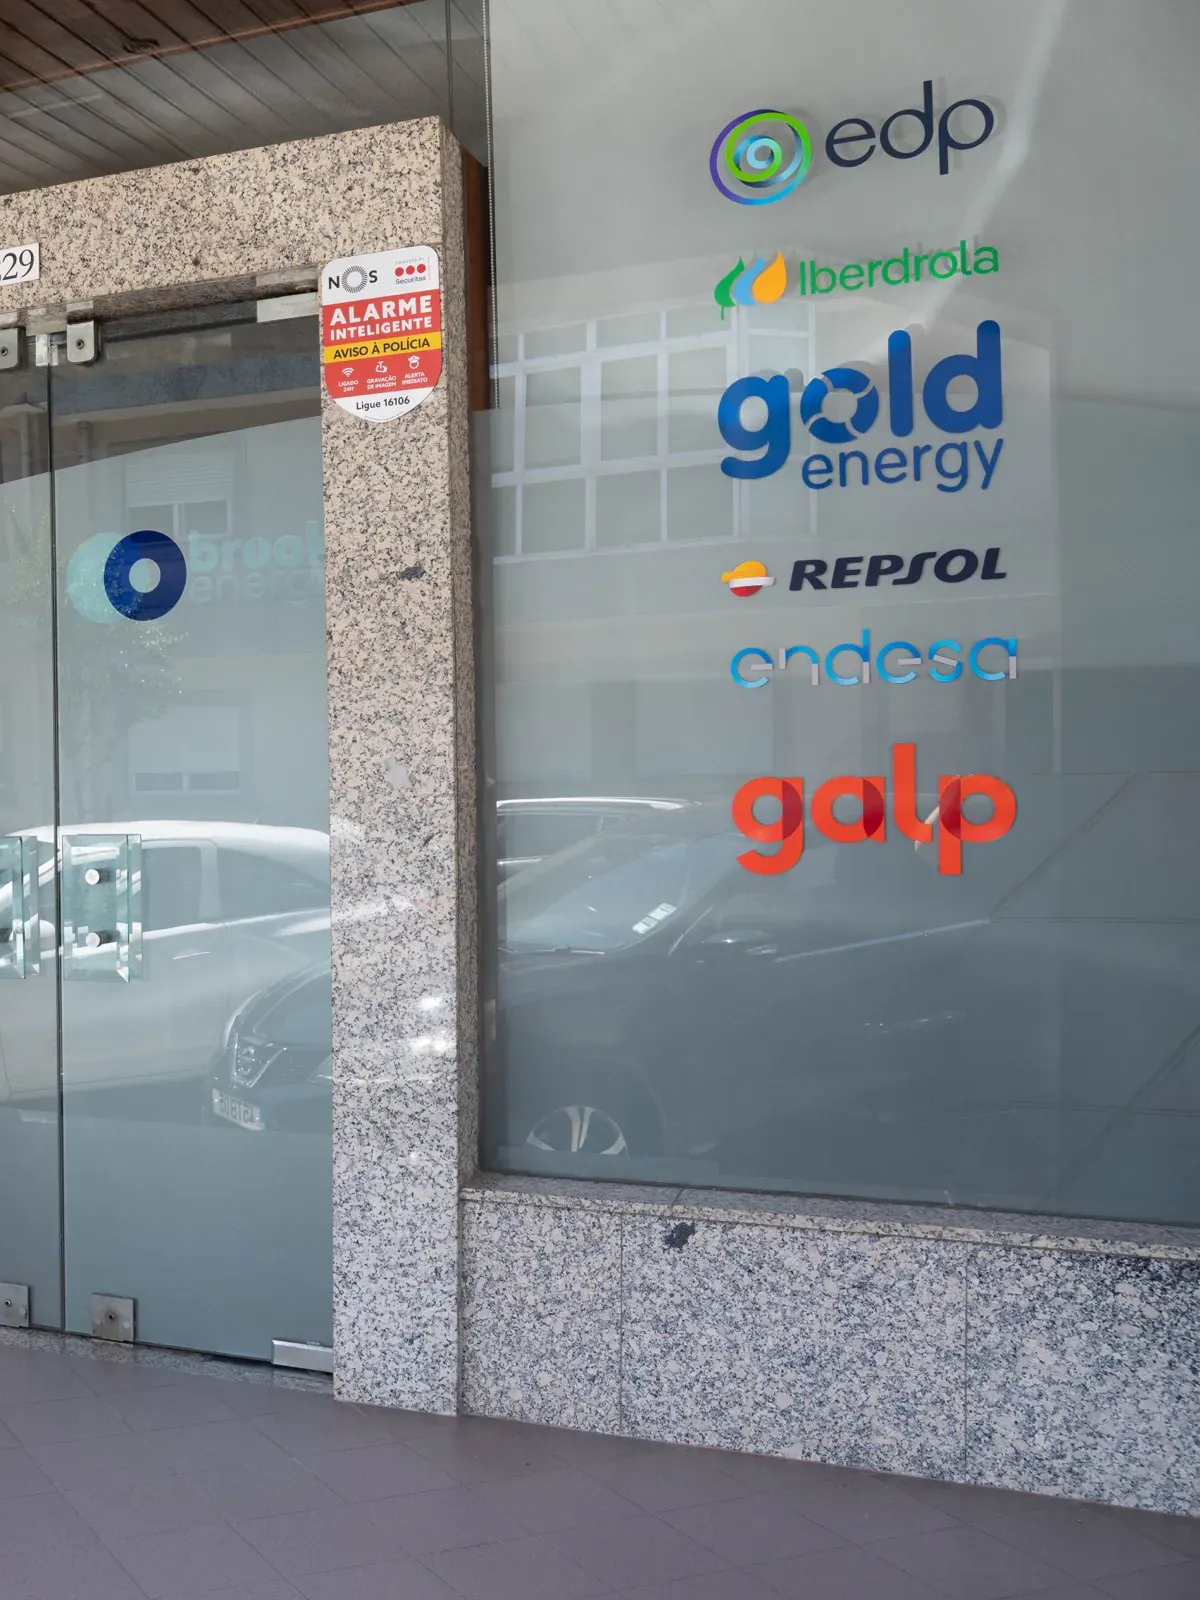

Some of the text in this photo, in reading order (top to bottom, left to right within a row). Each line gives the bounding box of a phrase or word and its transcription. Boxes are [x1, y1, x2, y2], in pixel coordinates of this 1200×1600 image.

[824, 80, 995, 175] edp
[328, 265, 378, 294] NOS
[395, 276, 426, 285] Securitas
[800, 239, 1000, 295] Iberdrola
[330, 295, 432, 326] ALARME
[330, 317, 432, 341] INTELIGENTE
[333, 337, 430, 359] AVISO À POLÍCIA
[366, 375, 396, 383] GRAVAÇÃO
[402, 377, 428, 385] IMEDIATO
[356, 396, 410, 411] Ligue 16106
[718, 319, 1003, 479] gold
[801, 438, 1004, 493] energy
[789, 547, 1007, 591] REPSOL
[730, 628, 1018, 688] endesa
[731, 743, 1017, 875] galp
